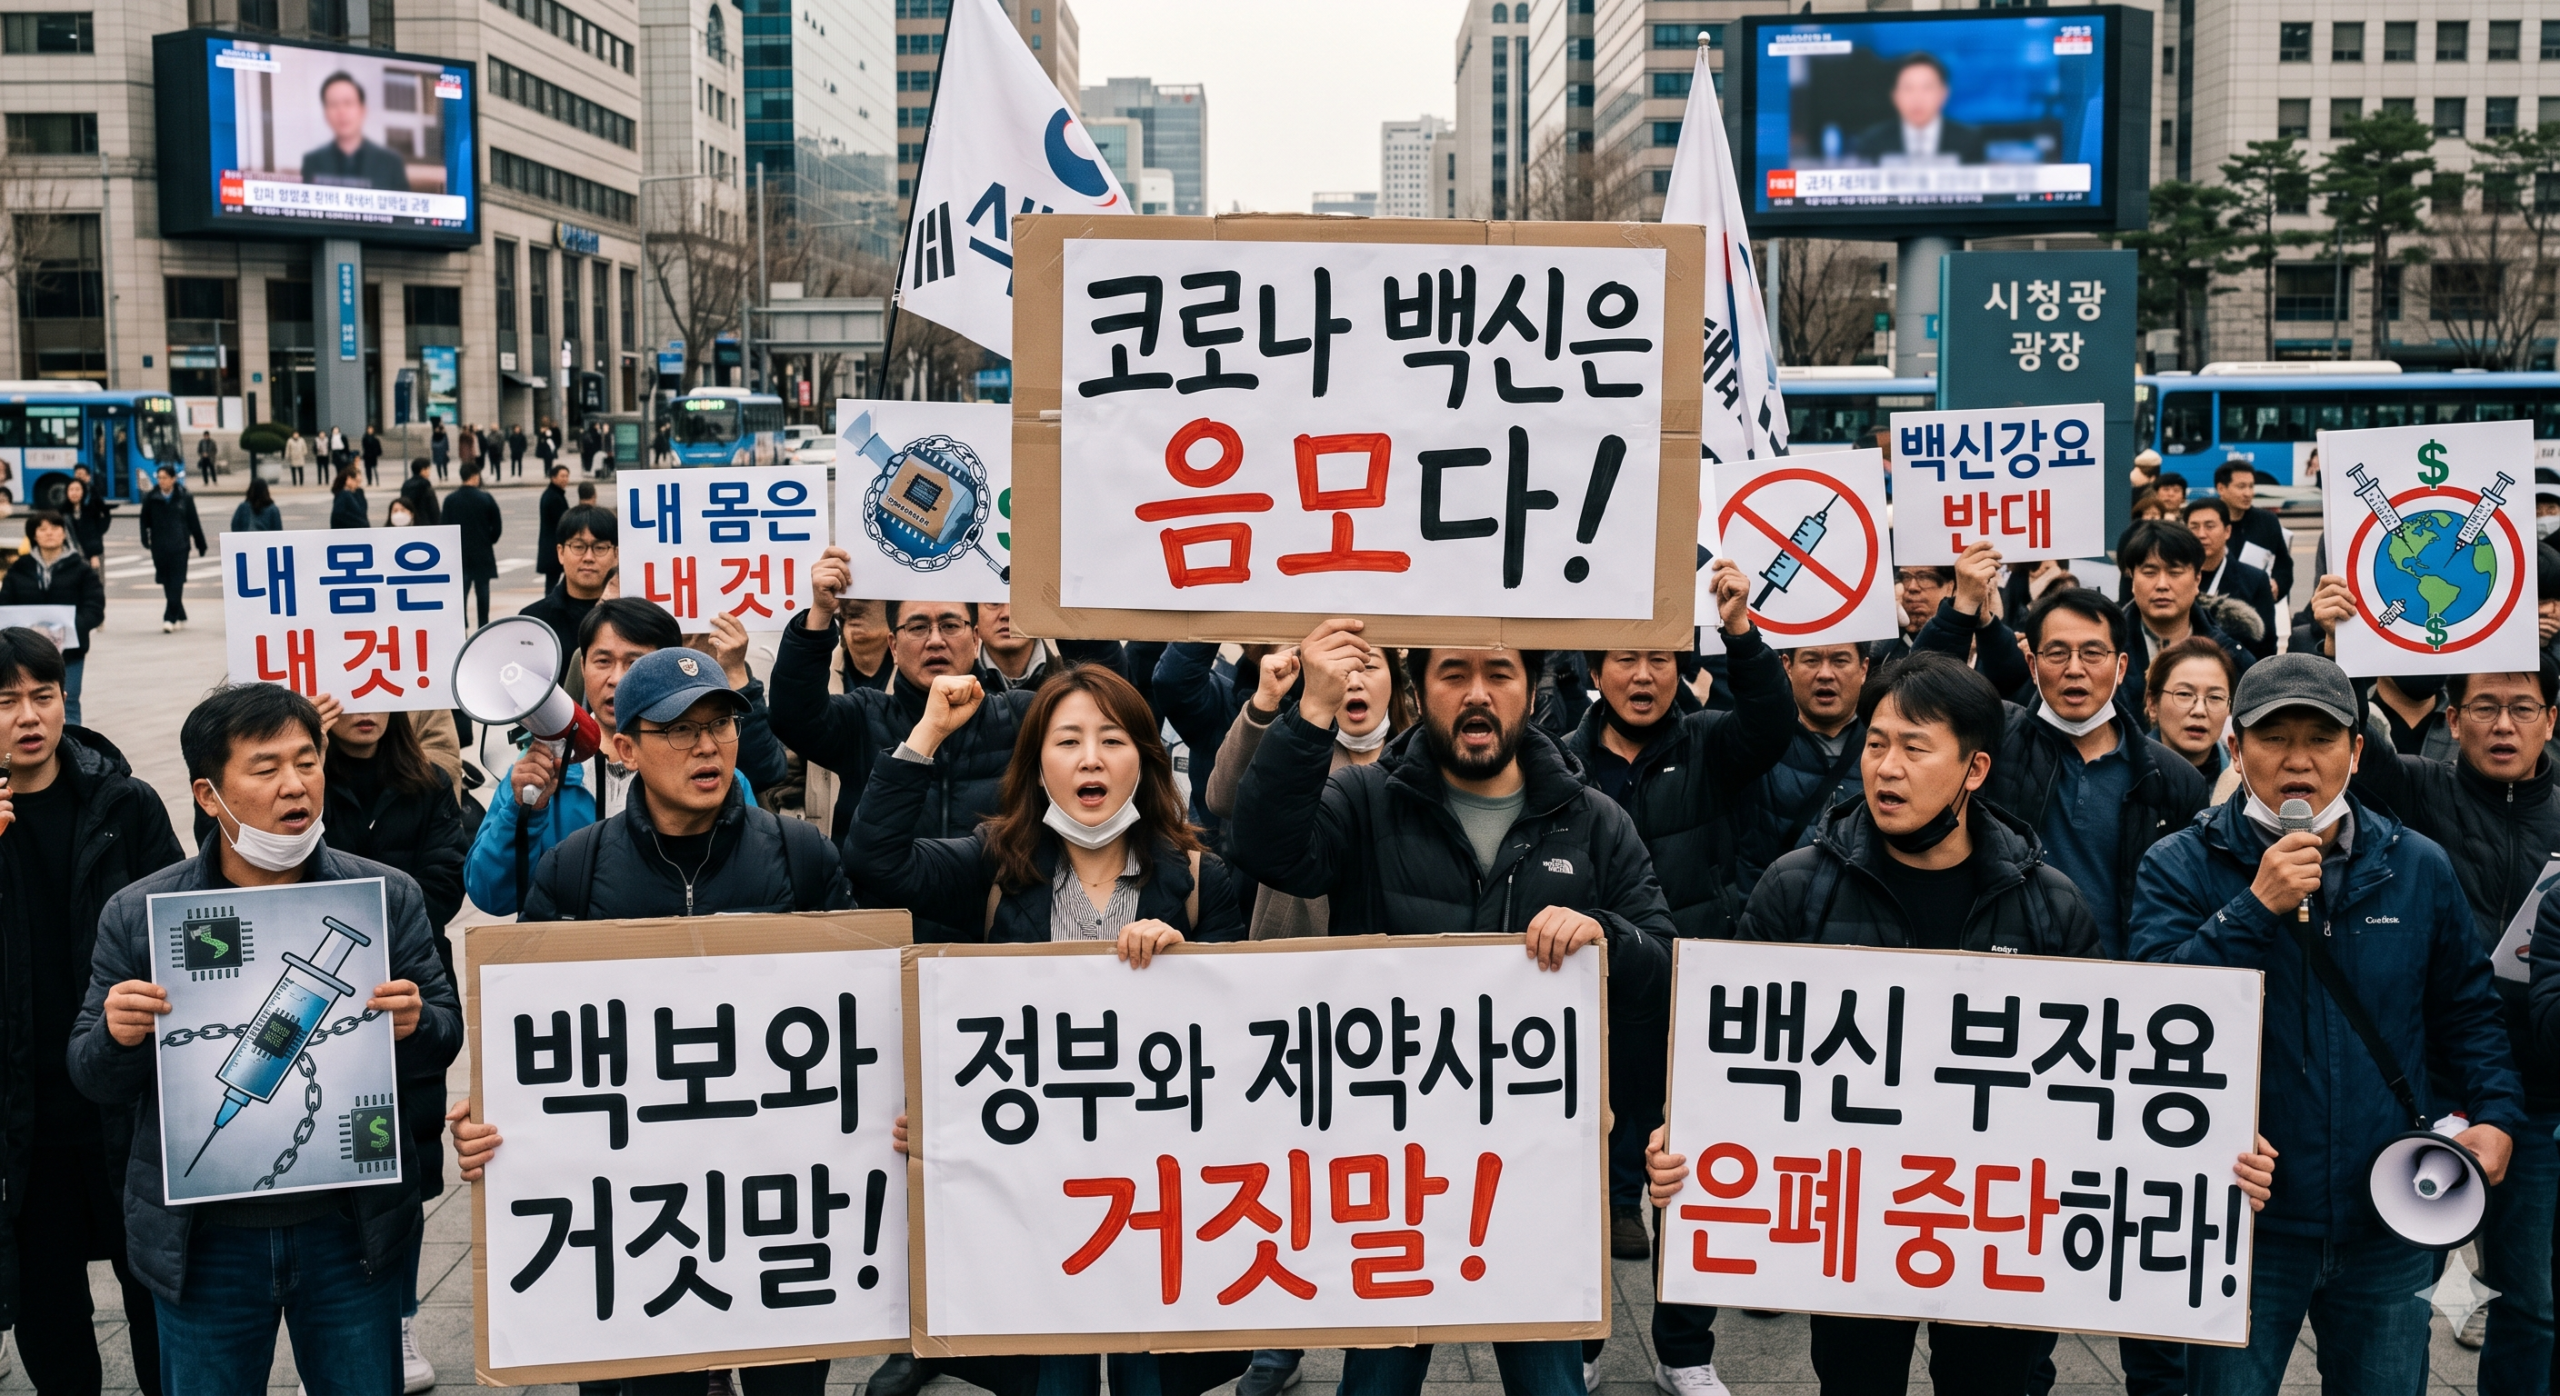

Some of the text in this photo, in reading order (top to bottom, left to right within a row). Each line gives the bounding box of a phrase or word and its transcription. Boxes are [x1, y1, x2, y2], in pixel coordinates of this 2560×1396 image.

[1077, 266, 1353, 398] 코로나
[1383, 264, 1653, 410] 백신은
[1984, 279, 2106, 321] 시청광
[2010, 331, 2085, 372] 광장
[1135, 417, 1627, 590] 음모다!
[1901, 419, 2096, 482] 백신강요
[629, 482, 682, 544] 내
[701, 480, 817, 544] 몸은
[1943, 488, 2051, 554] 반대
[235, 541, 450, 617] 내 몸은
[644, 554, 796, 619] 내 것!
[255, 625, 430, 699] 내 것!
[513, 992, 878, 1151] 백보와
[954, 993, 1578, 1145] 정부와 제약사의
[1708, 981, 2228, 1149] 백신 부작용
[510, 1163, 888, 1321] 거짓말!
[1061, 1142, 1503, 1306] 거짓말!
[1679, 1142, 2243, 1309] 은폐 중단하라!
